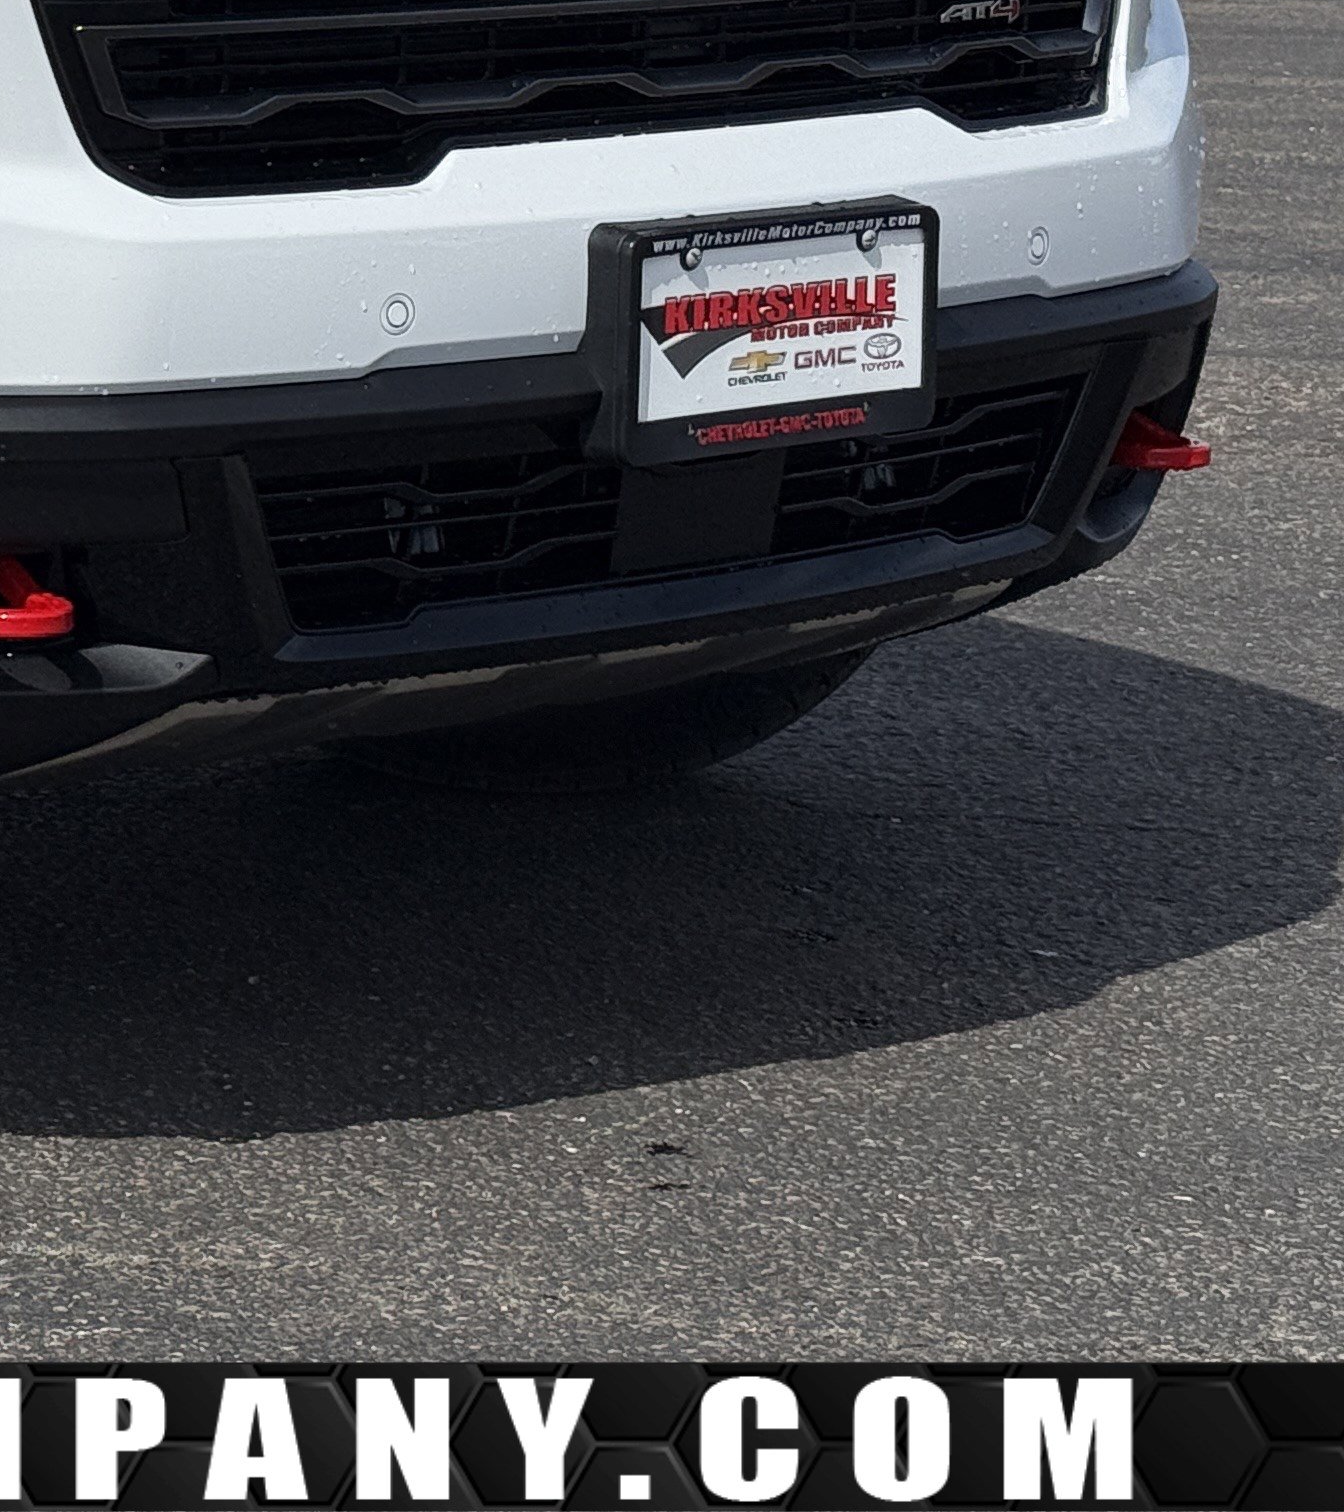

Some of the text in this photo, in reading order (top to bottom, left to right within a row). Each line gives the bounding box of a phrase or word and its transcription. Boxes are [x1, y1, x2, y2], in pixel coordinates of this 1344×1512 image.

[651, 213, 922, 254] www.KirksvilleMotorCompany.com
[663, 273, 897, 336] KIRKSVILLE
[750, 314, 896, 343] MOTOR COMPANY
[794, 345, 858, 370] GMC
[861, 359, 906, 373] TOYOTA
[727, 371, 789, 387] CHEVROLET
